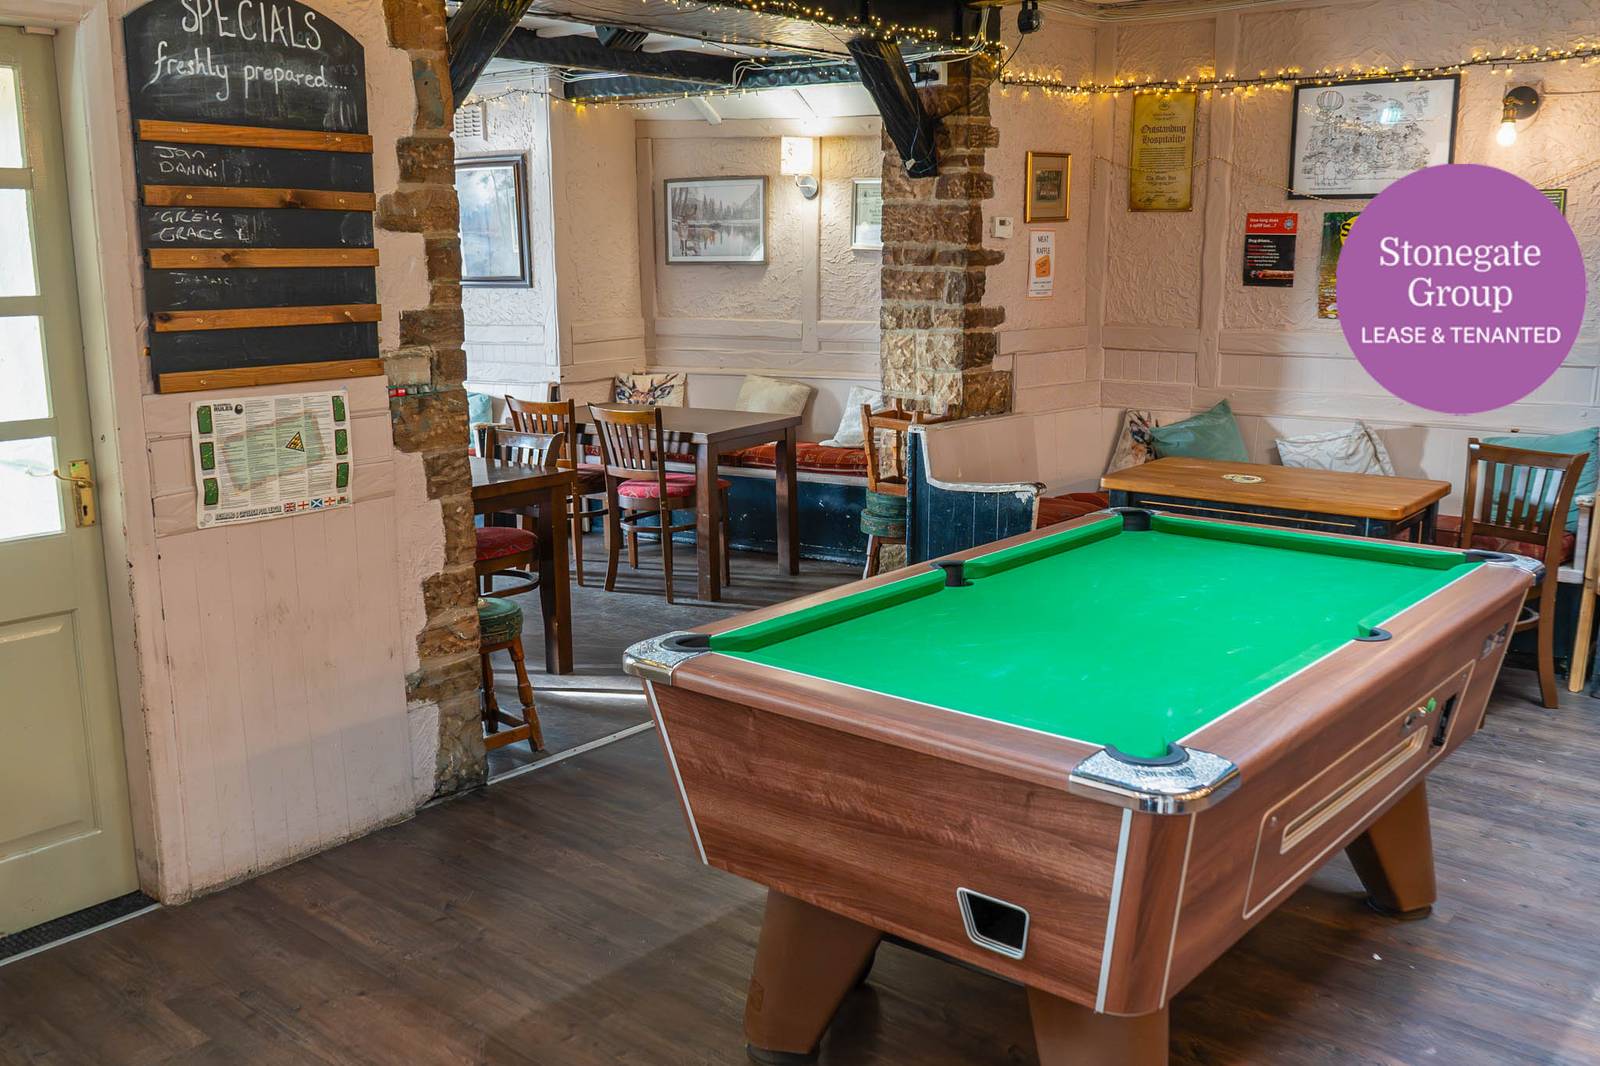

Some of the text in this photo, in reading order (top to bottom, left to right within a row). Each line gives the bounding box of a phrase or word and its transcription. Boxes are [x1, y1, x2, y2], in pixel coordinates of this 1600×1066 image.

[182, 0, 321, 50] SPECIALS
[141, 41, 230, 101] freshly
[1141, 125, 1186, 134] Outstanding
[1142, 135, 1185, 144] Hospitality
[160, 227, 224, 242] GRACE
[1037, 235, 1049, 243] MEAT
[1036, 247, 1050, 255] RAFFLE
